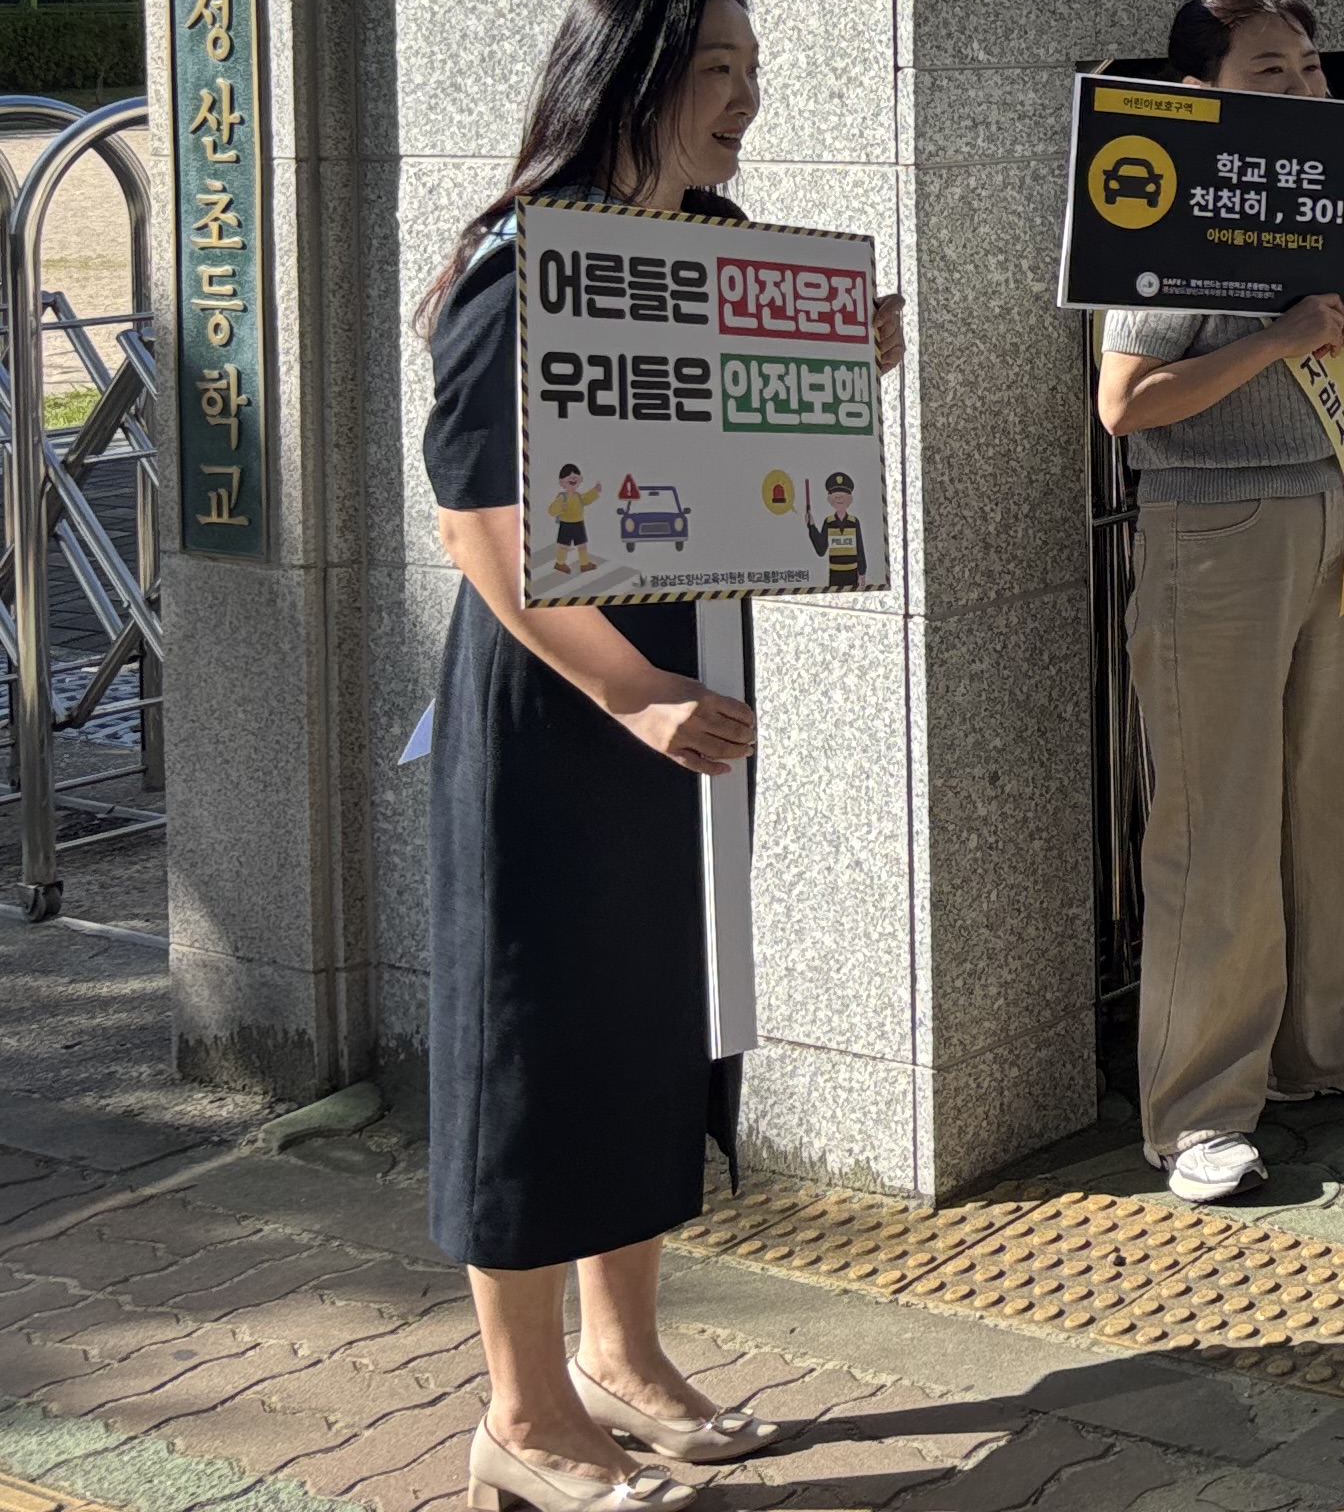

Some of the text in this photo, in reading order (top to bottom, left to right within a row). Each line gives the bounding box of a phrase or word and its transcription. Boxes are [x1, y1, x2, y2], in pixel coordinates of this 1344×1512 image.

[1123, 97, 1193, 114] 어린이보호구역
[1216, 152, 1326, 190] 학교 앞은
[1295, 197, 1344, 225] 30!
[1206, 228, 1324, 251] 아이들이 먼저입니다
[539, 249, 867, 337] 어른들은 안전운전
[540, 351, 871, 427] 우리들은 안전보행
